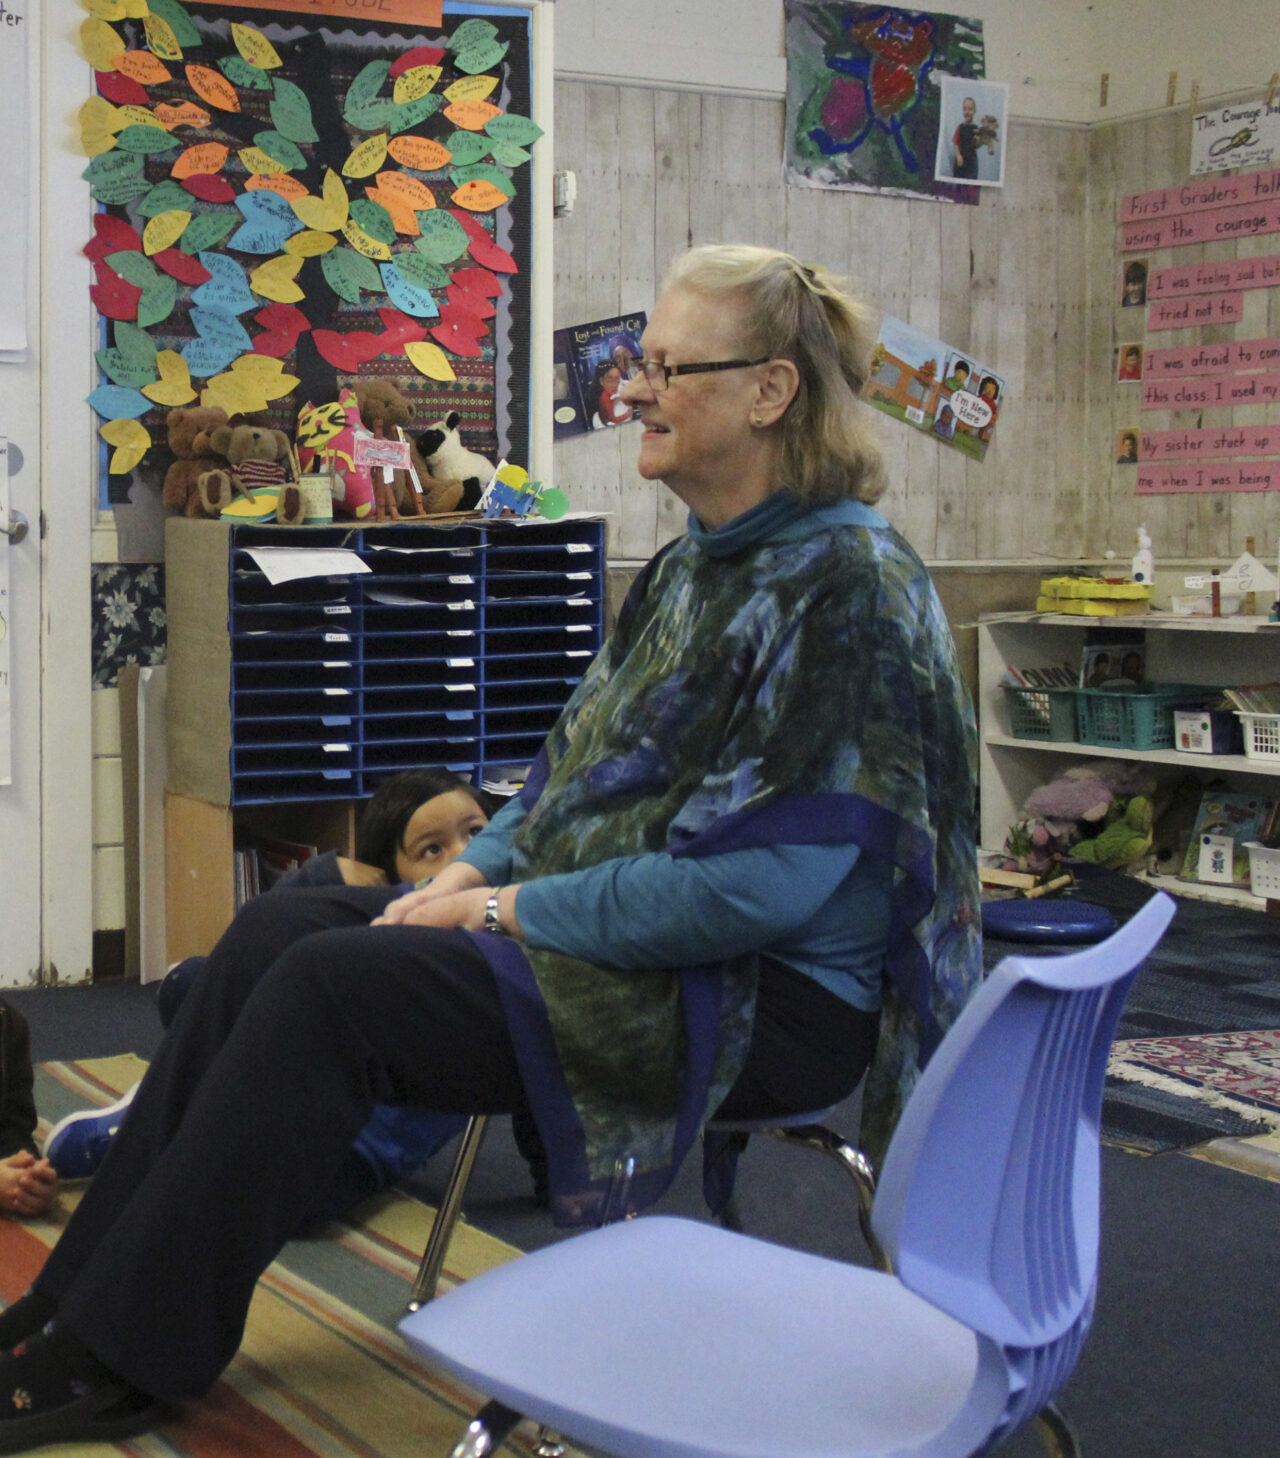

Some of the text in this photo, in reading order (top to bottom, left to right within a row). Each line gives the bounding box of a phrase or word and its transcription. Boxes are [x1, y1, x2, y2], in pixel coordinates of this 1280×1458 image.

[1195, 114, 1215, 131] The
[1130, 192, 1167, 215] First
[1180, 186, 1239, 206] Graders
[1125, 231, 1161, 247] using
[1172, 219, 1193, 239] the
[1215, 215, 1268, 233] courage
[1156, 275, 1164, 290] I
[1172, 277, 1190, 288] was
[1237, 266, 1255, 281] sad
[1159, 304, 1189, 320] tried
[1195, 304, 1212, 318] not
[1147, 355, 1154, 371] I
[1164, 361, 1184, 369] was
[1192, 348, 1230, 368] afraid
[1238, 347, 1252, 362] to
[1144, 387, 1169, 403] this
[1216, 383, 1223, 400] I
[1232, 380, 1256, 397] used
[1262, 387, 1278, 400] my
[954, 393, 991, 418] I'm New
[958, 407, 980, 424] Here
[1142, 432, 1270, 457] My sister stuck up
[1138, 469, 1271, 489] me when I was being
